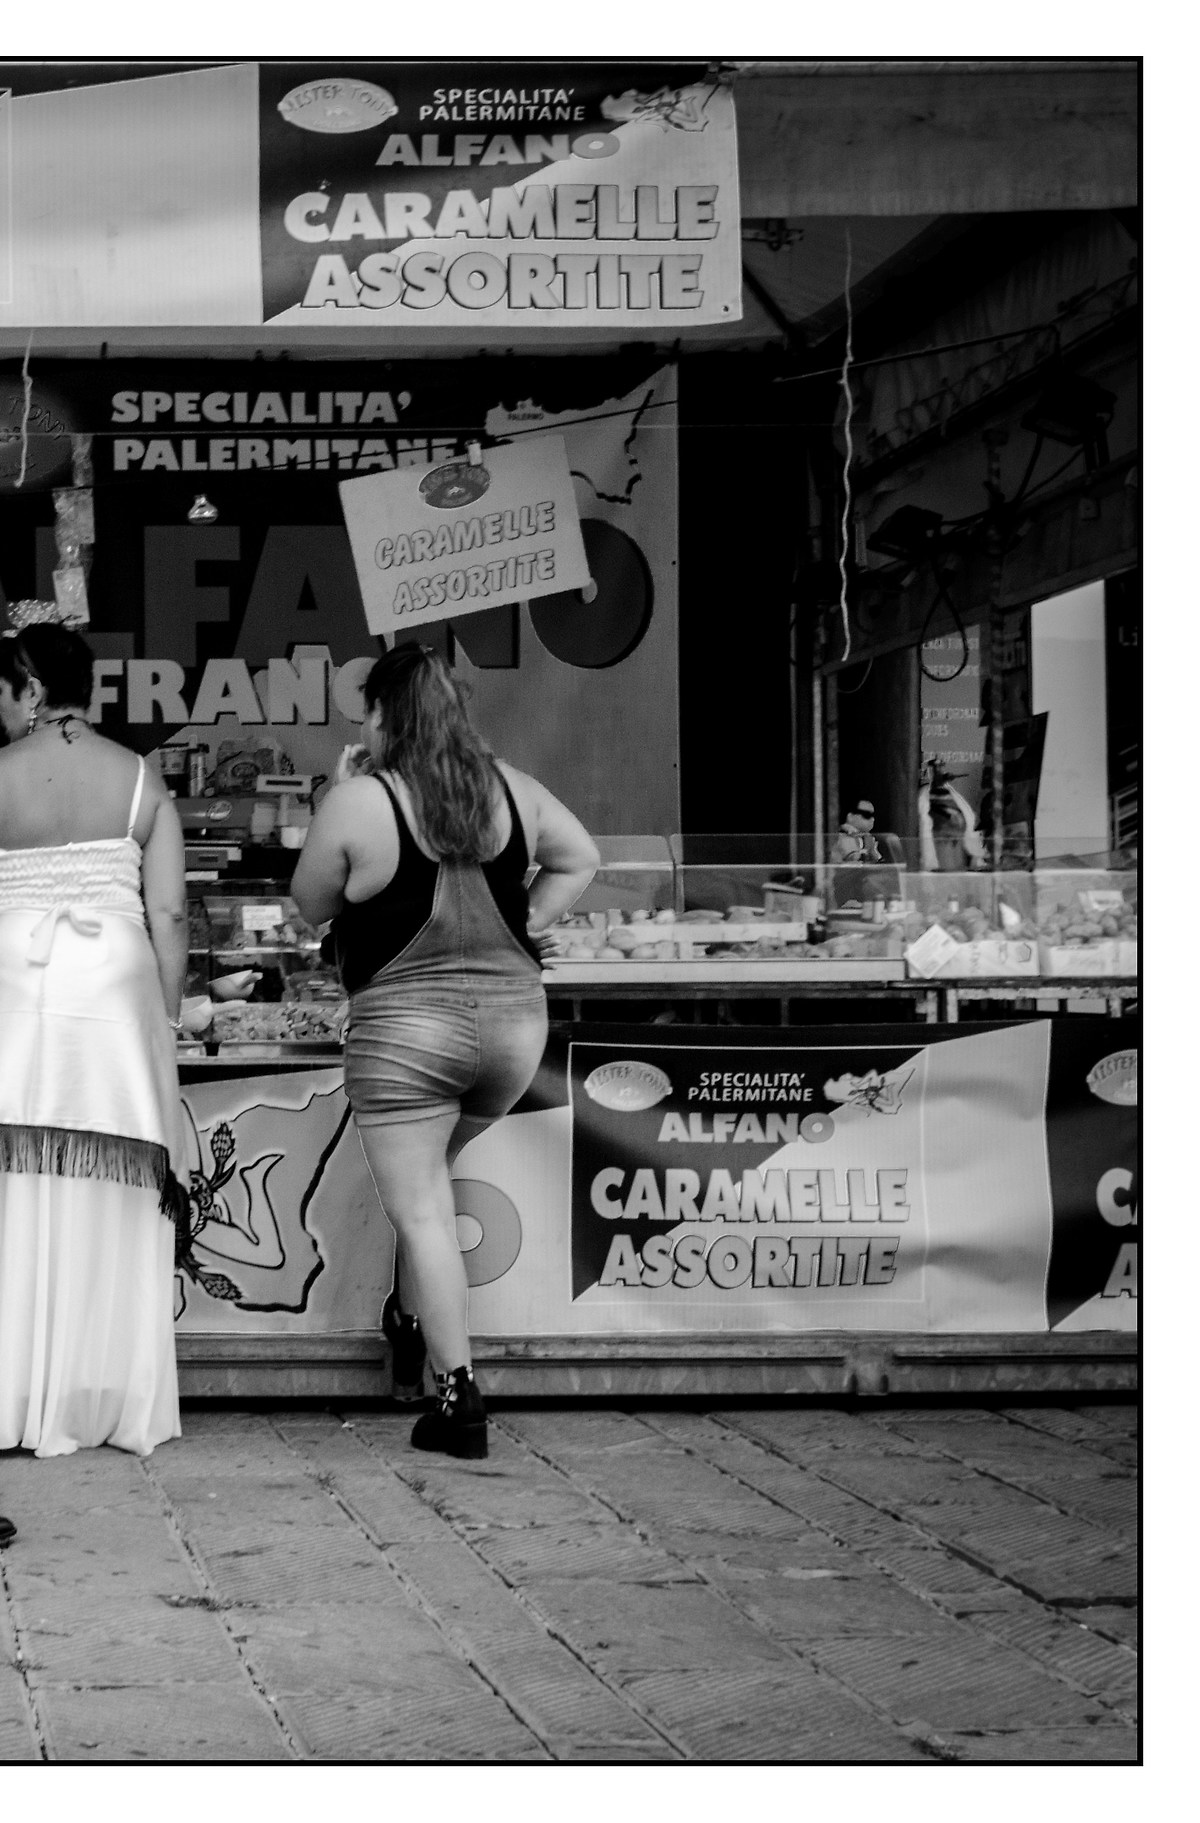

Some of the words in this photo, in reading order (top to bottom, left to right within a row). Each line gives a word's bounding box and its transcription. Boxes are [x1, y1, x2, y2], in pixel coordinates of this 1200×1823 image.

[419, 104, 586, 122] PALERMITANE
[432, 87, 575, 105] SPECIALITA'
[375, 132, 621, 167] ALFANO
[284, 183, 721, 243] CARAMELLE
[299, 251, 705, 312] ASSORTITE
[110, 390, 413, 424] SPECIALITA'
[112, 436, 462, 472] PALERMITANE
[374, 499, 557, 571] CARAMELLE
[392, 548, 557, 617] ASSORTITE
[688, 1086, 813, 1102] PALERMITANE
[699, 1072, 806, 1087] SPECIALITA'
[657, 1112, 835, 1143] ALFANO
[590, 1167, 910, 1223] CARAMELLE
[599, 1234, 900, 1289] ASSORTITE
